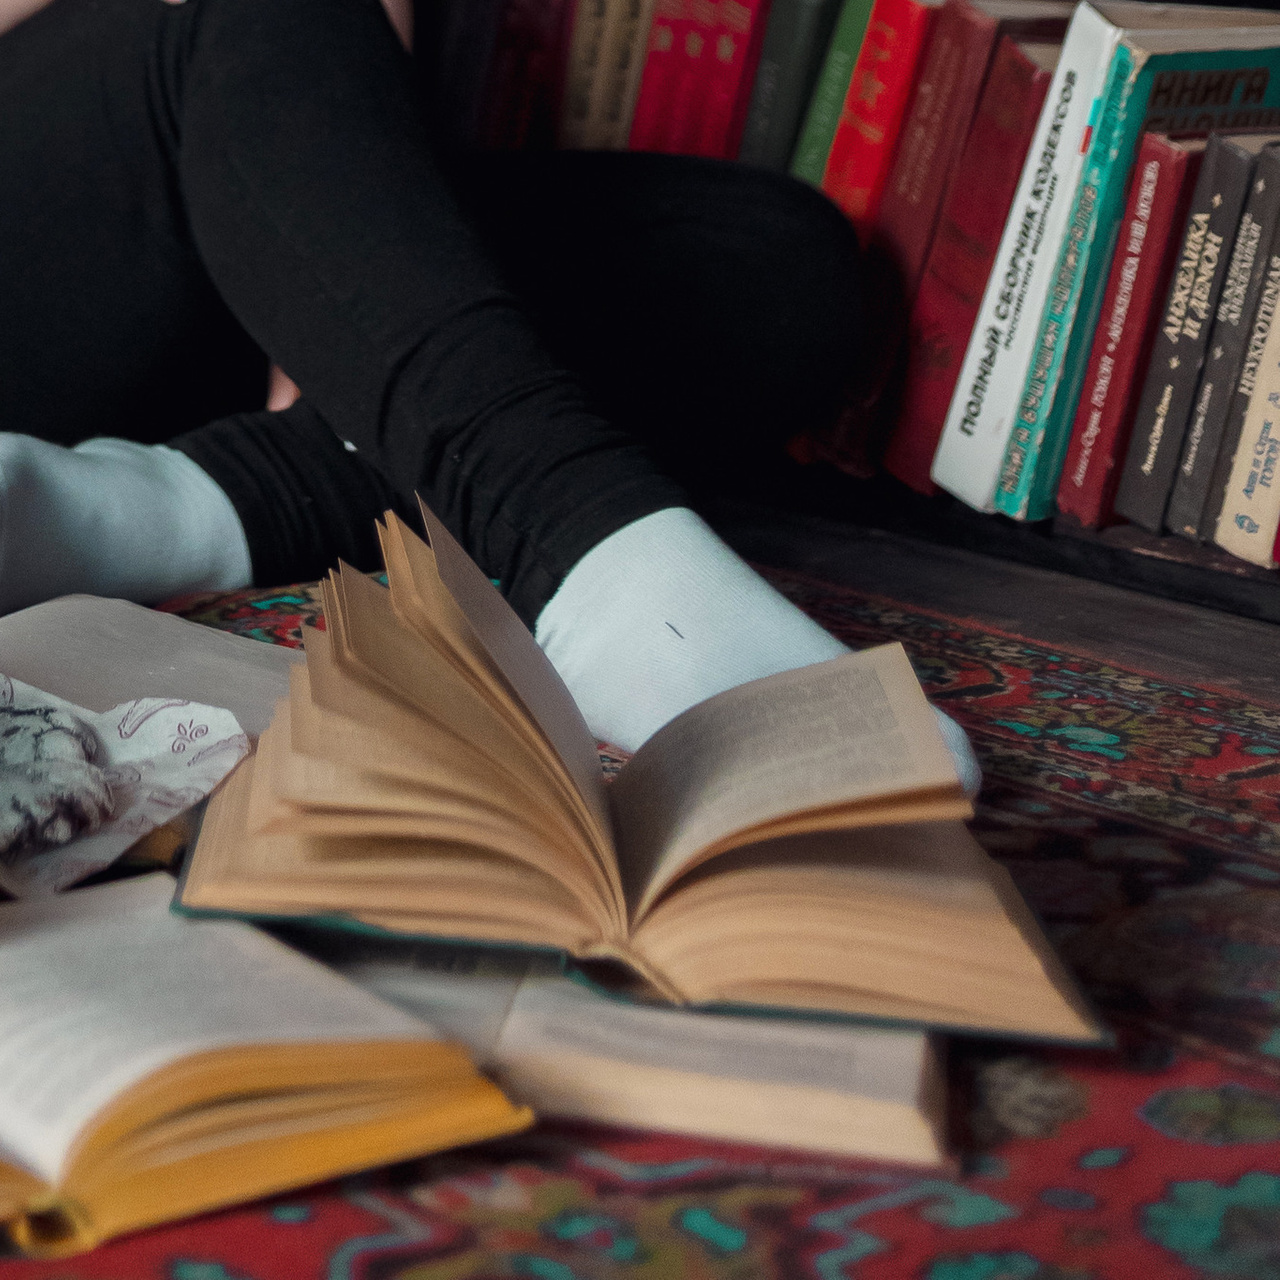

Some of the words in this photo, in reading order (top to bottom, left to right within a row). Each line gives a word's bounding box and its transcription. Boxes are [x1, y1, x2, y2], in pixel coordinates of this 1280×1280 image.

[959, 328, 1002, 436] ПОЛНЫЙ
[995, 208, 1038, 321] СБОРНИК
[1030, 69, 1077, 200] КОДЕКСОВ
[1163, 213, 1210, 343] АНЖЕЛИКА
[1188, 234, 1223, 317] ДЕМОН
[1228, 222, 1262, 325] АНЖЕЛИКИ
[1183, 320, 1200, 340] И
[1238, 255, 1280, 396] НЕУКРОТИМАЯ
